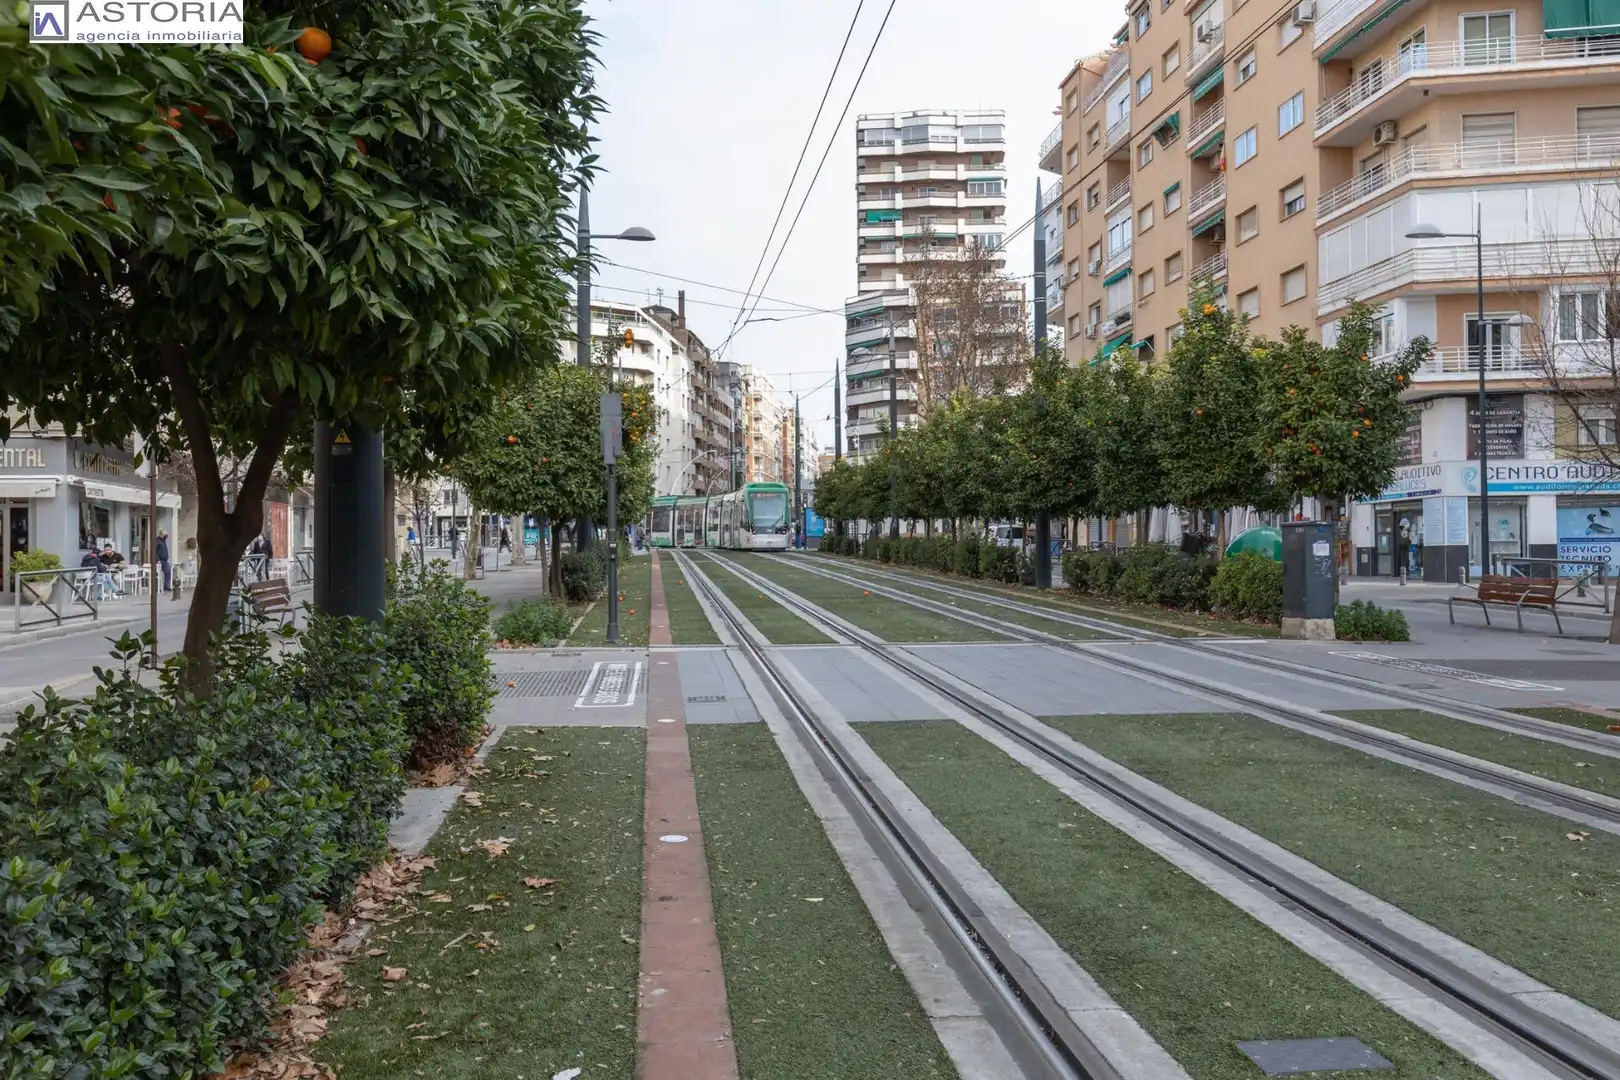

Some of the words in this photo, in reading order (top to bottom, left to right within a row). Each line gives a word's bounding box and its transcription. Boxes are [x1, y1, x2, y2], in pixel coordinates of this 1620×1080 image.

[1401, 464, 1442, 480] AUDITIVO
[1486, 466, 1559, 480] CENTRO
[1560, 545, 1612, 553] SERVICIO
